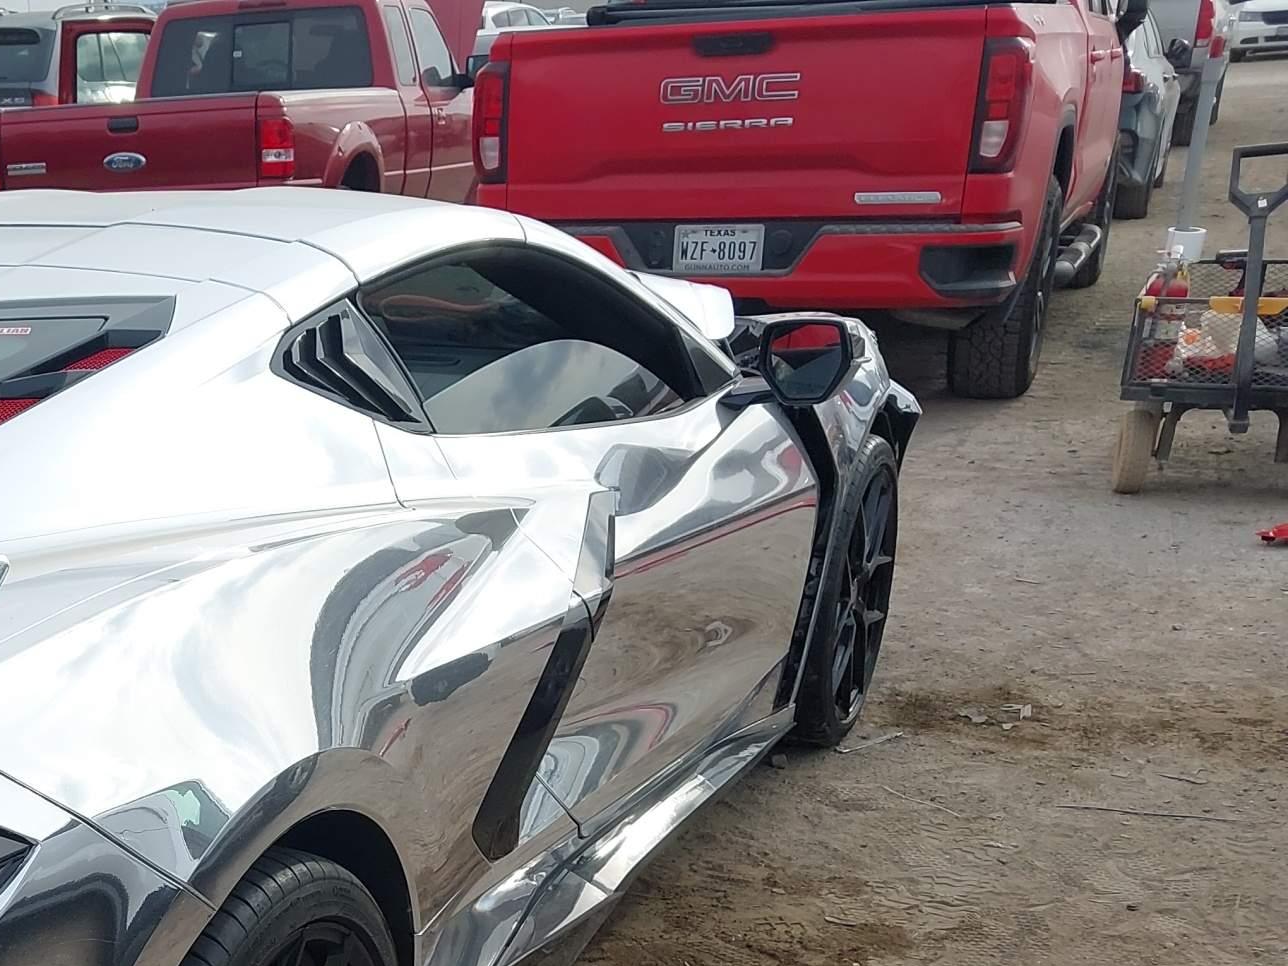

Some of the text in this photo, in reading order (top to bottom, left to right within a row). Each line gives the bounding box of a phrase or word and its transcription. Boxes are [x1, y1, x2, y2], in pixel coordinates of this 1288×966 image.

[659, 72, 801, 104] GMC
[662, 117, 794, 132] SIERRA
[703, 229, 737, 237] TEXAS
